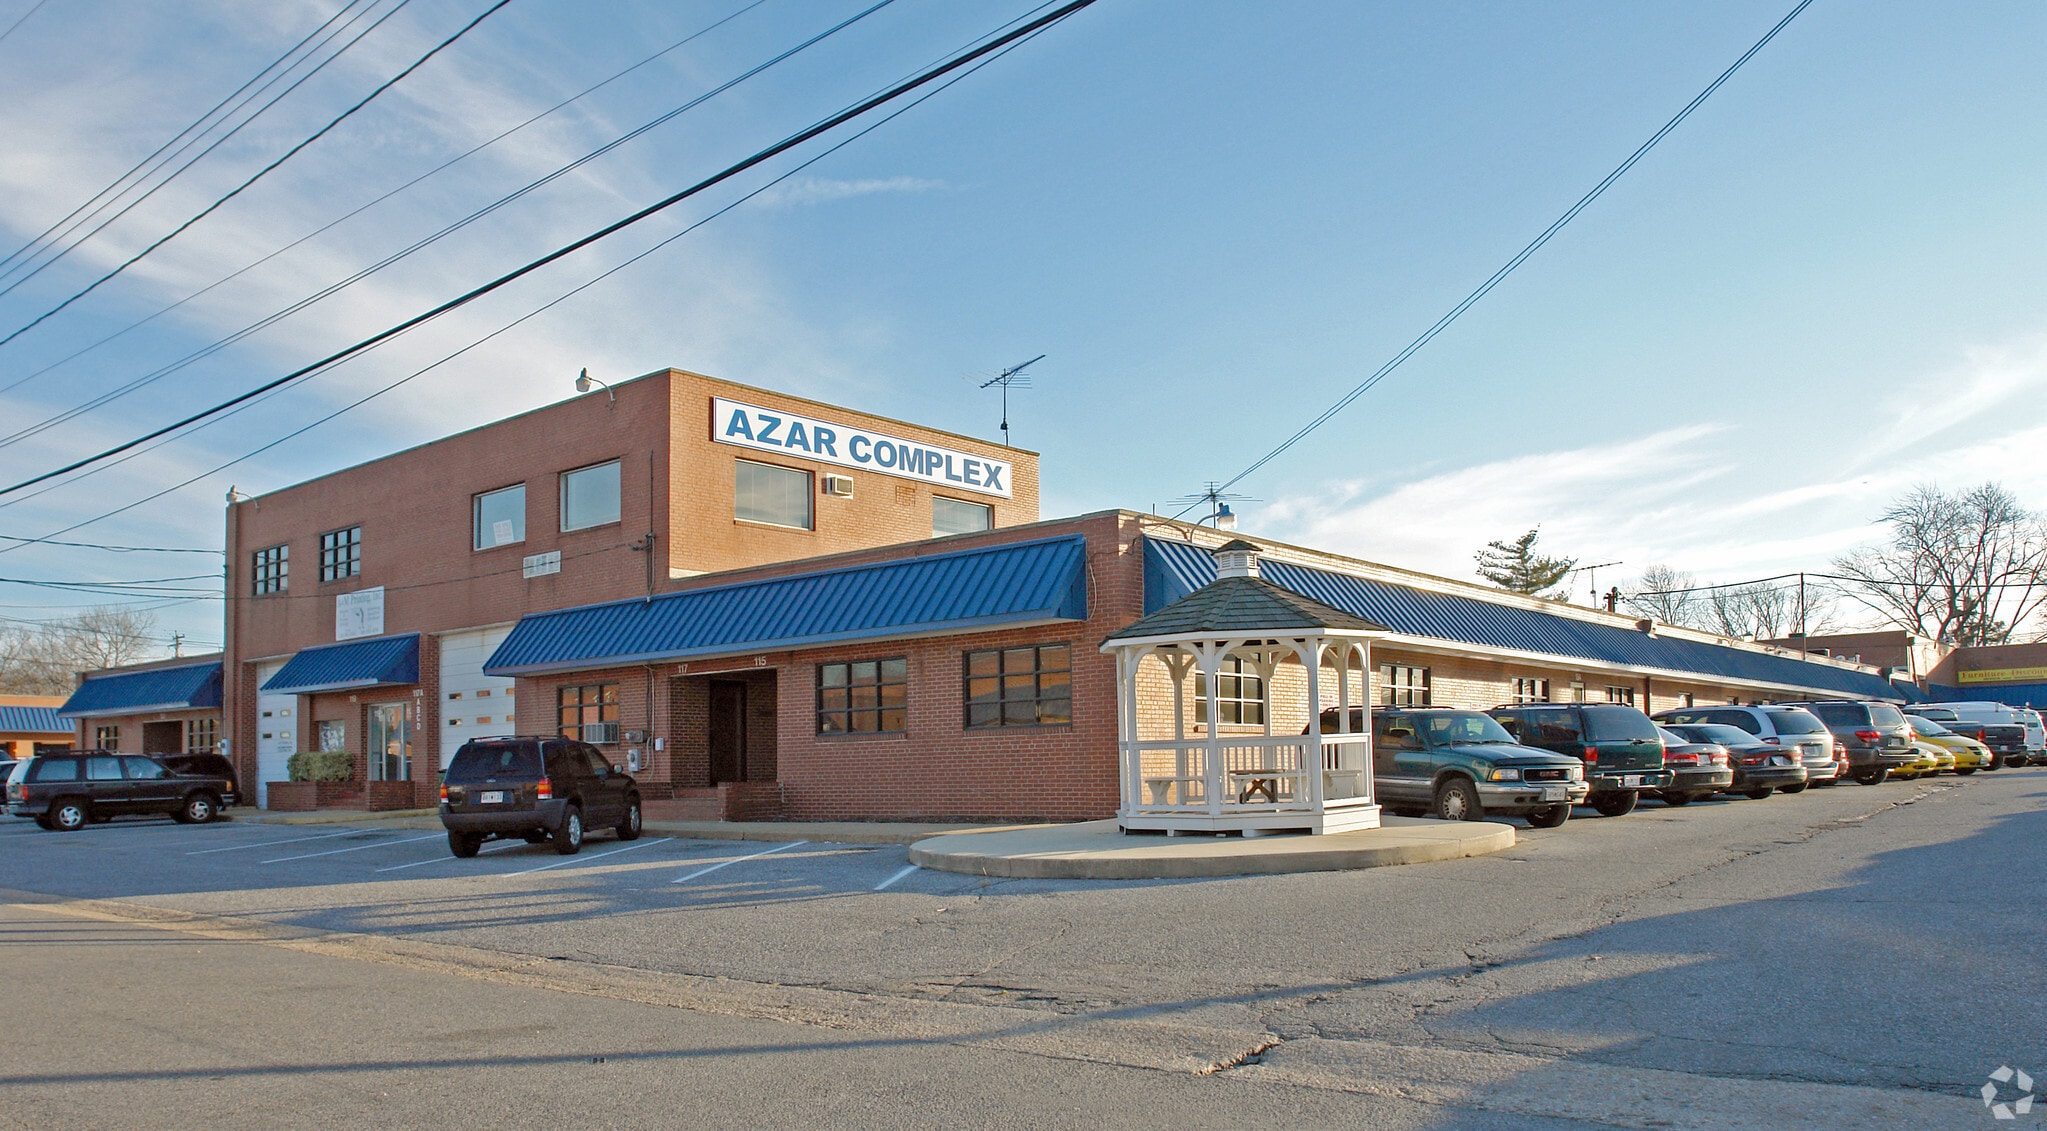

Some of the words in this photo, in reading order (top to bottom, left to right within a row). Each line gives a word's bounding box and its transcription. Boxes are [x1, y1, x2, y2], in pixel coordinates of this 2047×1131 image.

[725, 408, 838, 457] AZAR
[848, 434, 1003, 491] COMPLEX
[754, 656, 767, 666] 115
[678, 664, 688, 674] 117
